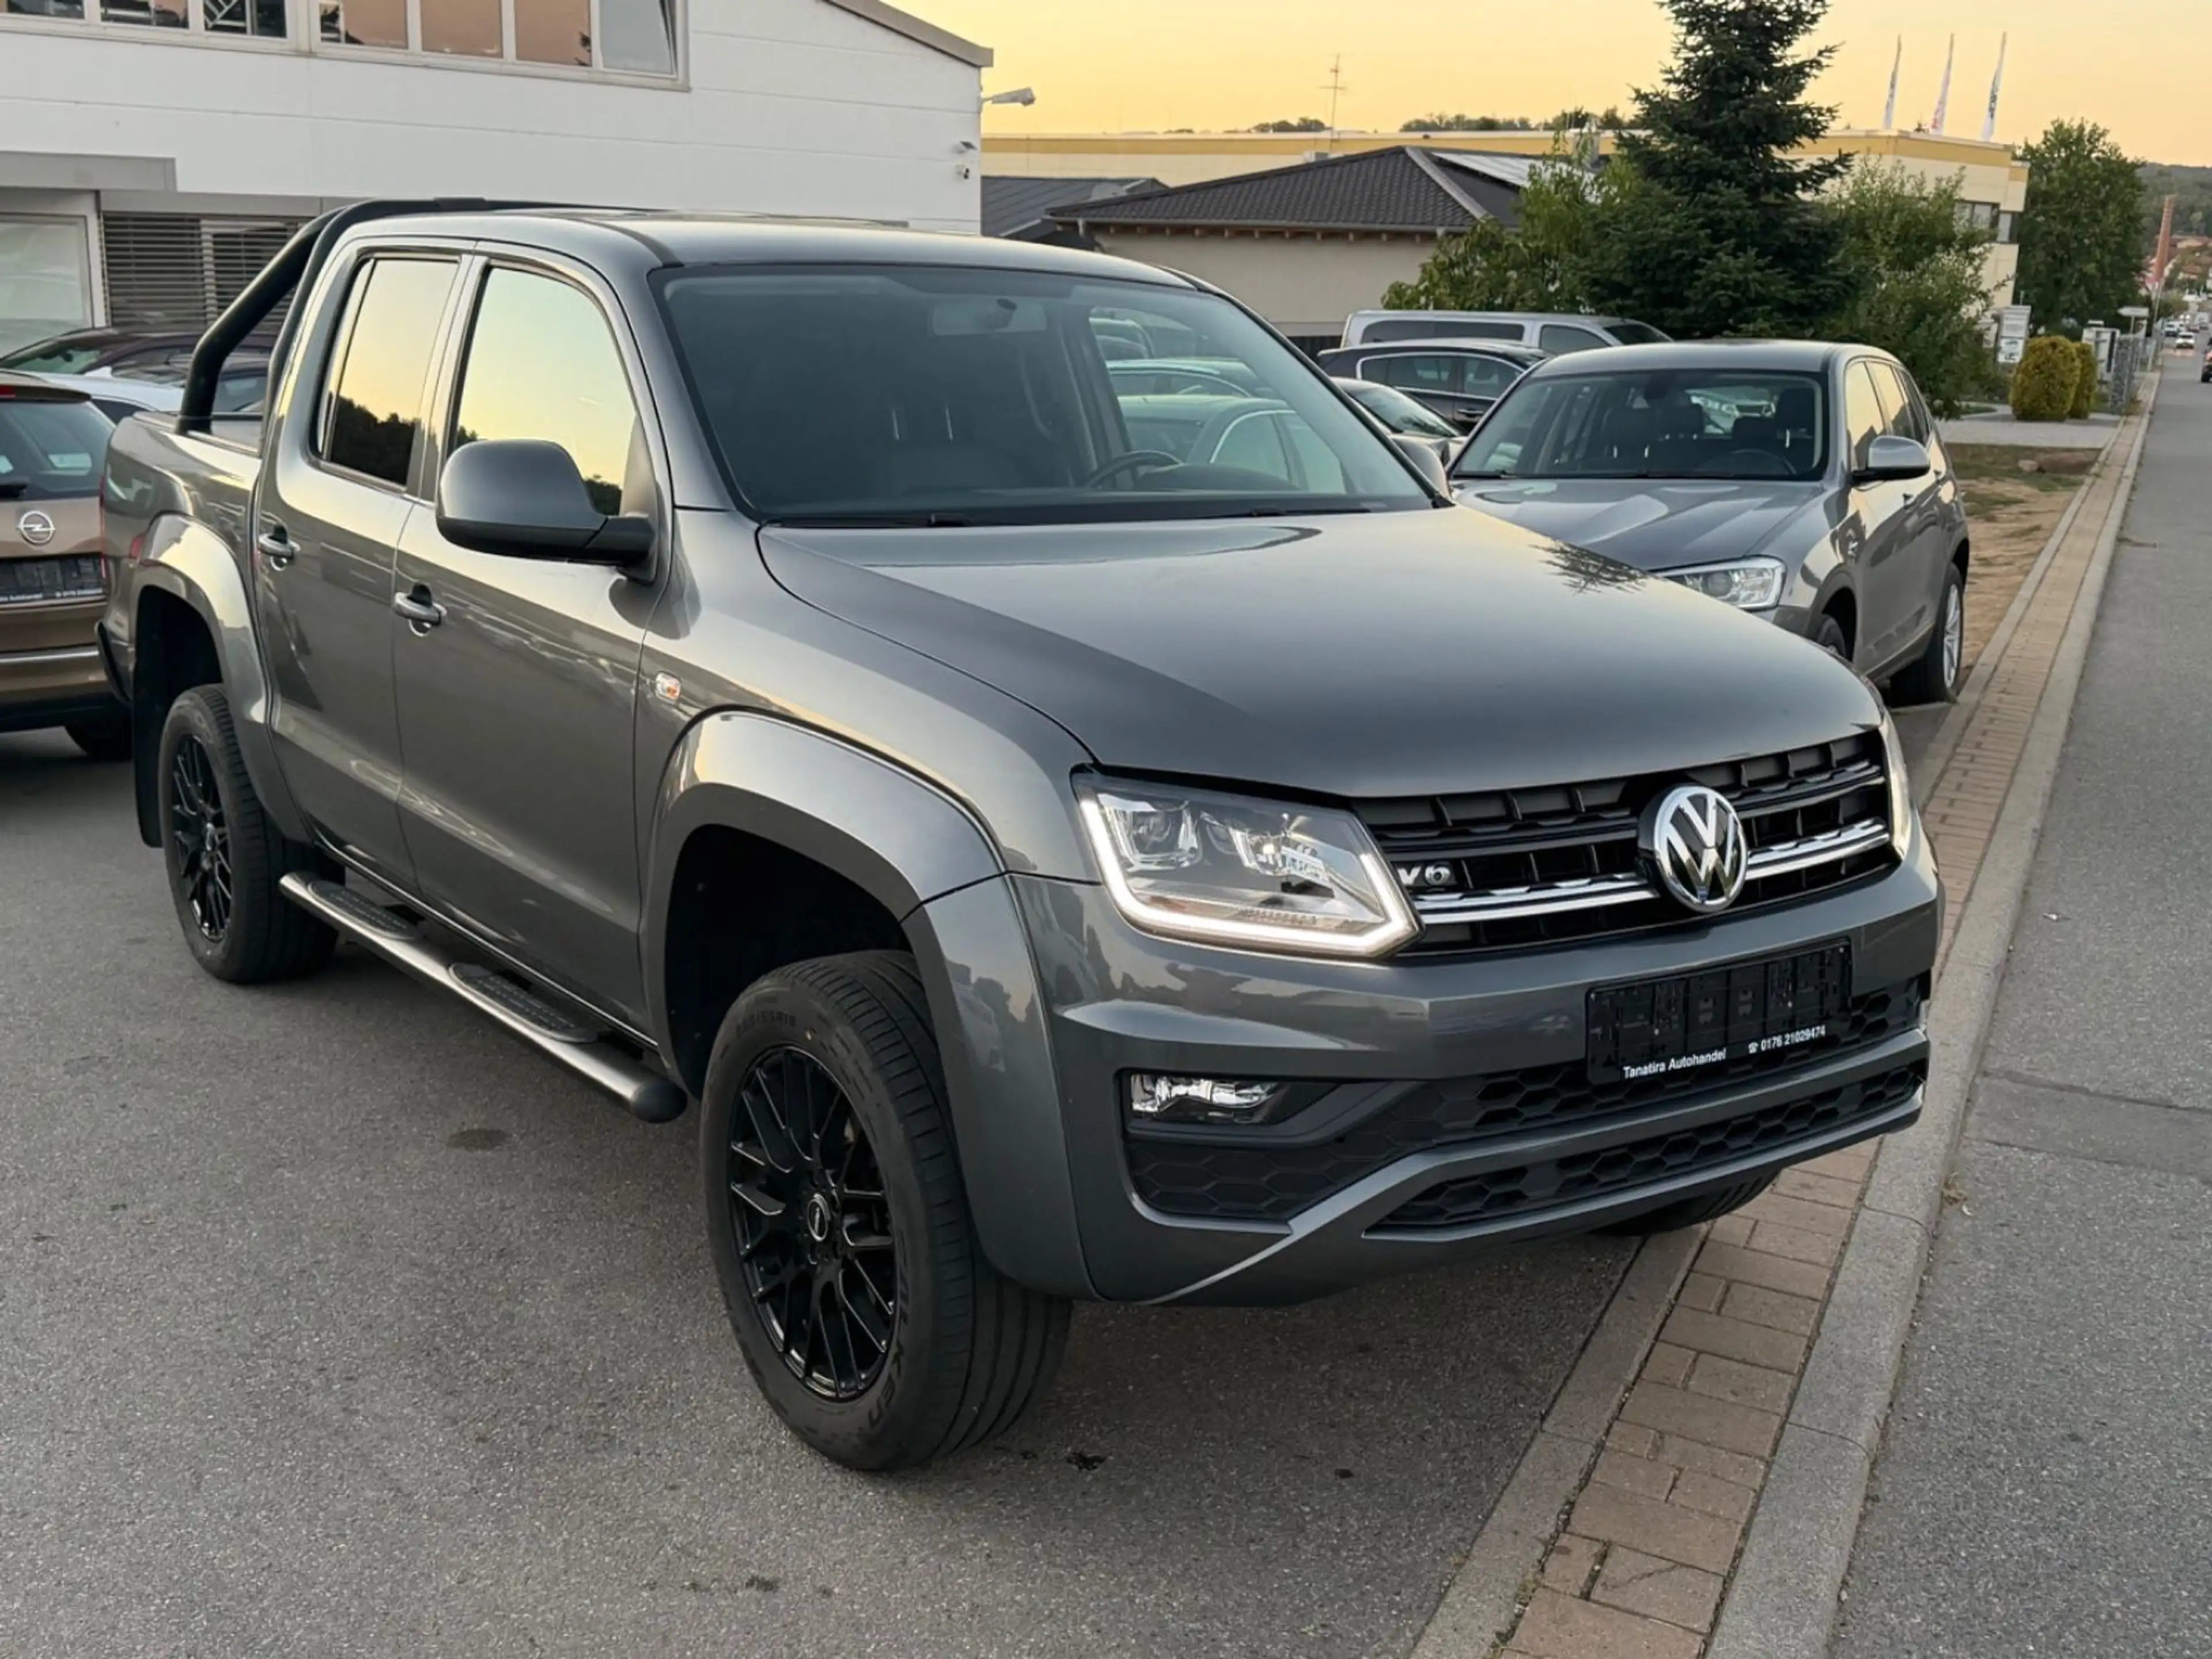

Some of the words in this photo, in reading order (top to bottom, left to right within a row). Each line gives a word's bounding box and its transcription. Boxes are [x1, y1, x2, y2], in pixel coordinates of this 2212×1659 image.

[1397, 866, 1450, 885] V6
[1668, 1047, 1727, 1071] Autohandel
[1760, 1034, 1782, 1051] 0176
